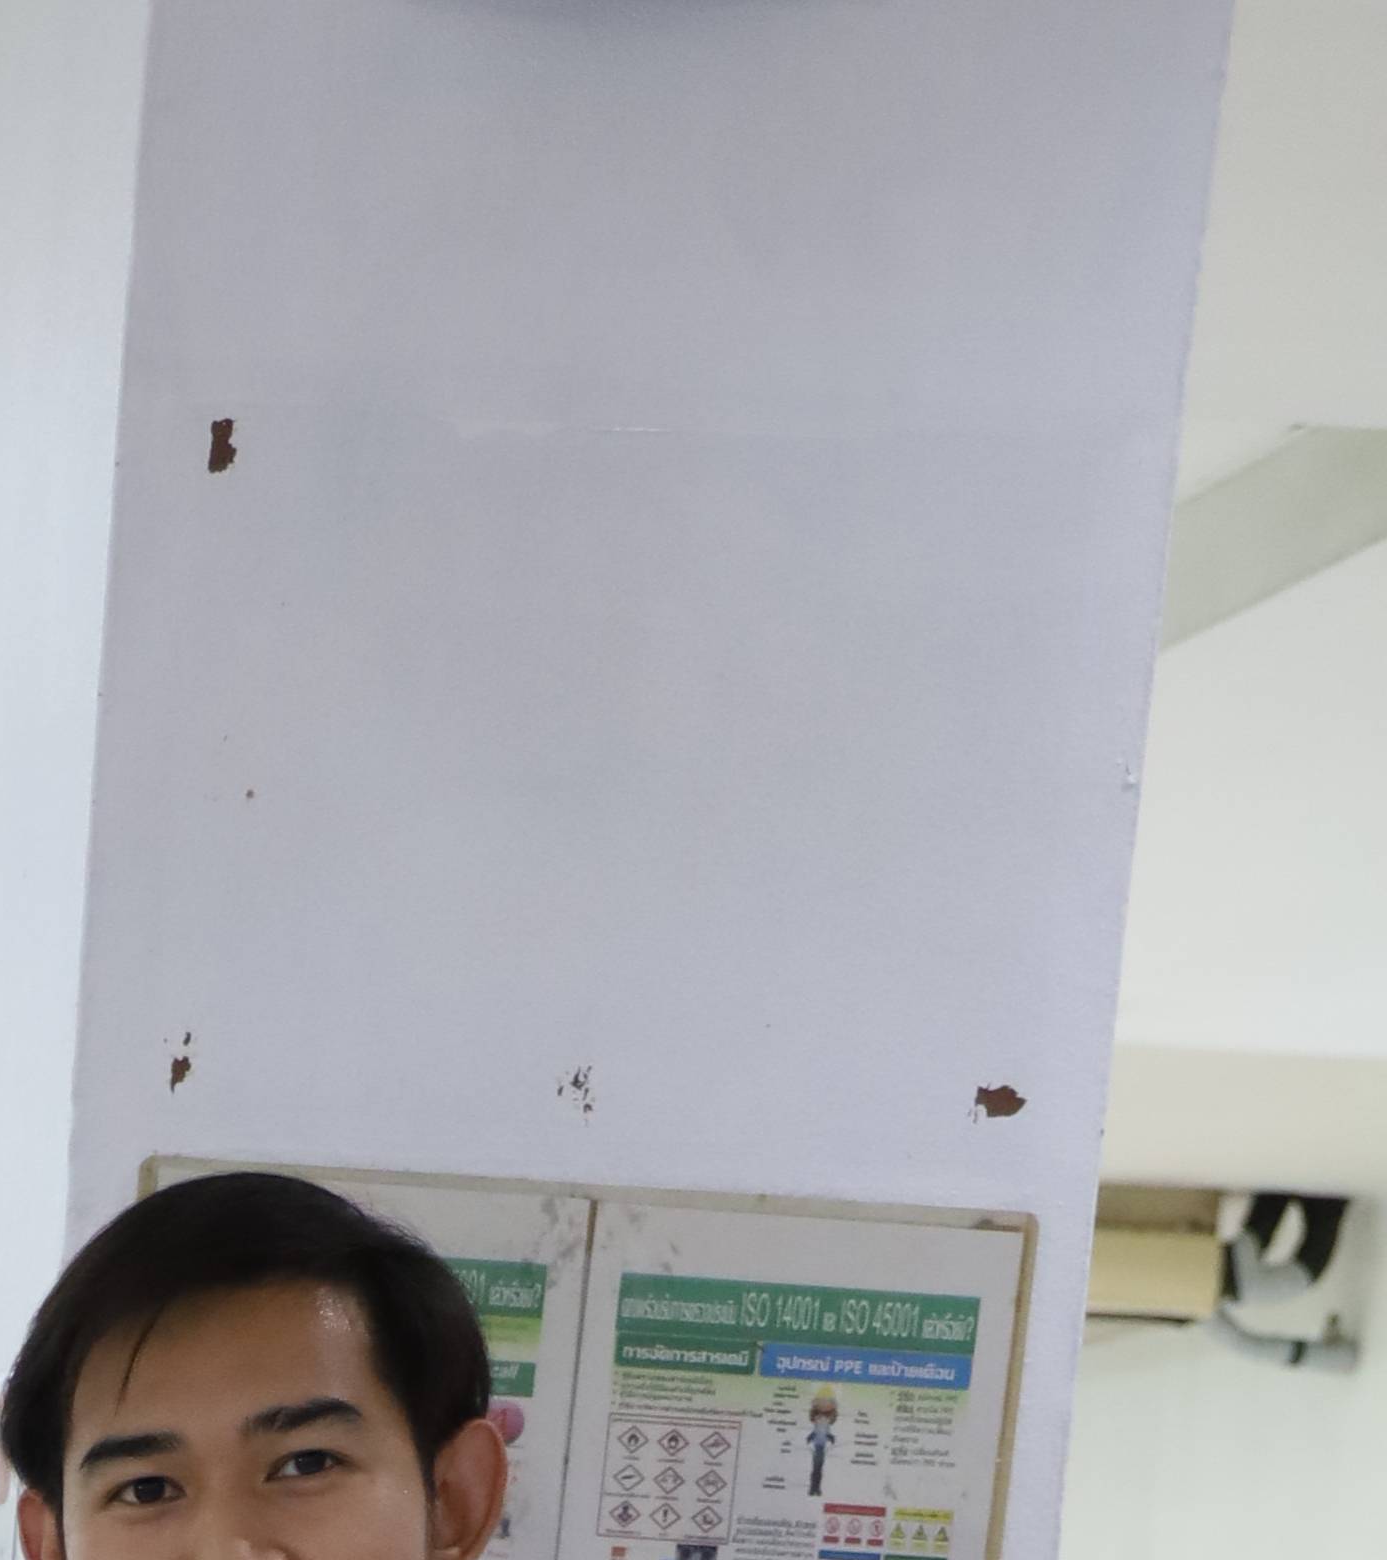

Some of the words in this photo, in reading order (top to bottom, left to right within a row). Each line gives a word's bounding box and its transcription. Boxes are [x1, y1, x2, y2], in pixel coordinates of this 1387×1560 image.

[741, 1292, 769, 1327] ISO
[776, 1295, 820, 1331] 14001
[840, 1299, 869, 1335] ISO
[872, 1302, 920, 1338] 45001
[834, 1359, 863, 1375] PPE
